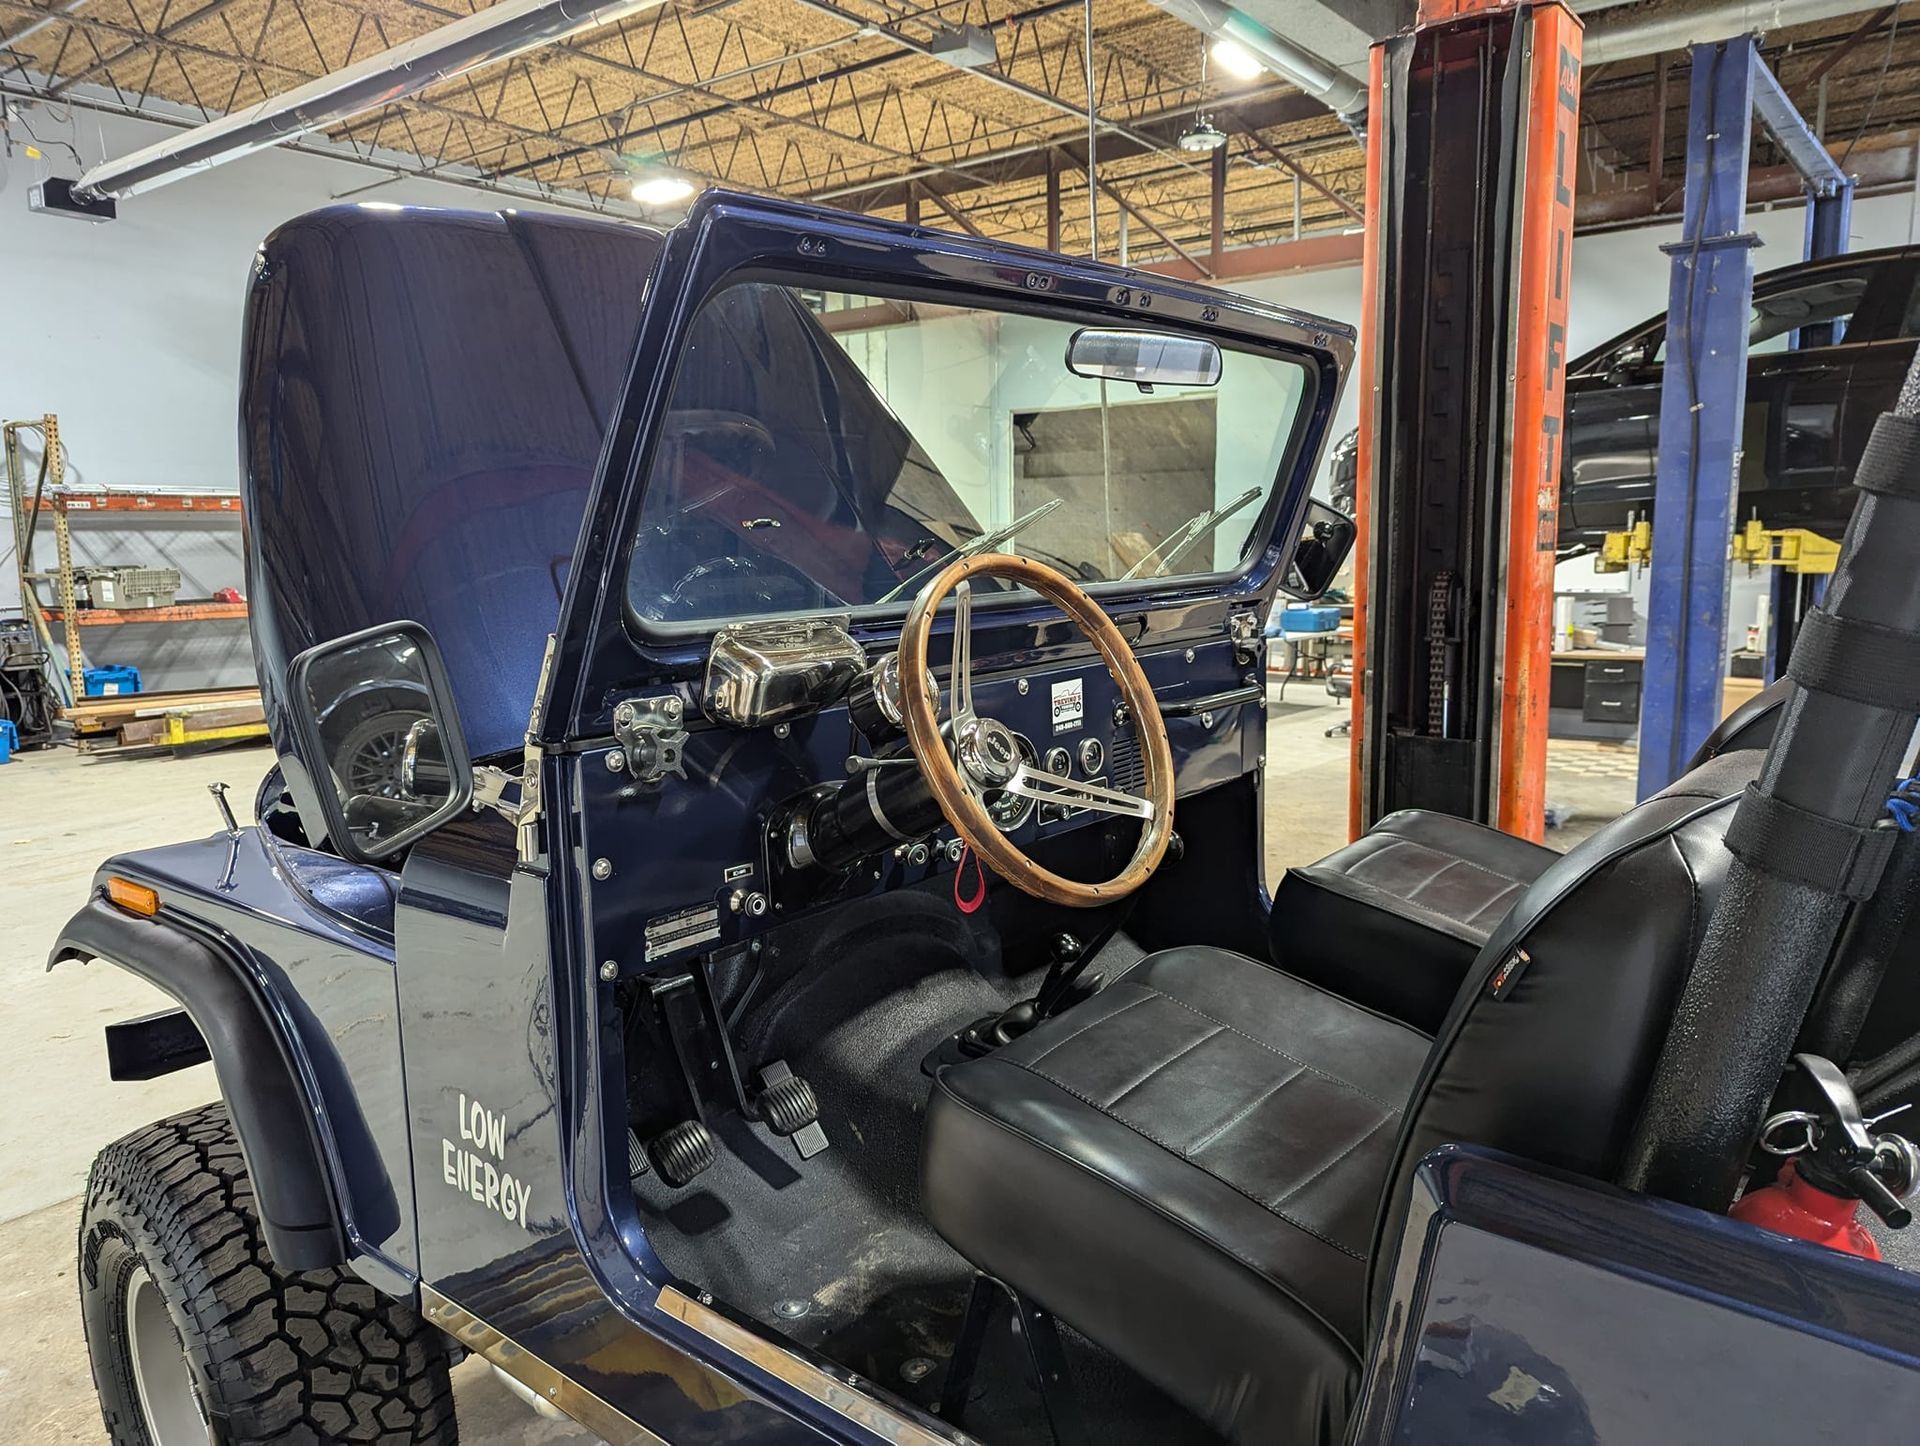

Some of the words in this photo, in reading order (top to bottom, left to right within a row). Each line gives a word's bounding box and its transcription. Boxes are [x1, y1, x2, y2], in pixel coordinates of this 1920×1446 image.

[1541, 130, 1572, 483] LIFT
[988, 736, 1010, 760] Jeep
[680, 905, 709, 917] Corporation
[459, 1093, 506, 1160] LOW
[442, 1138, 532, 1229] ENERGY
